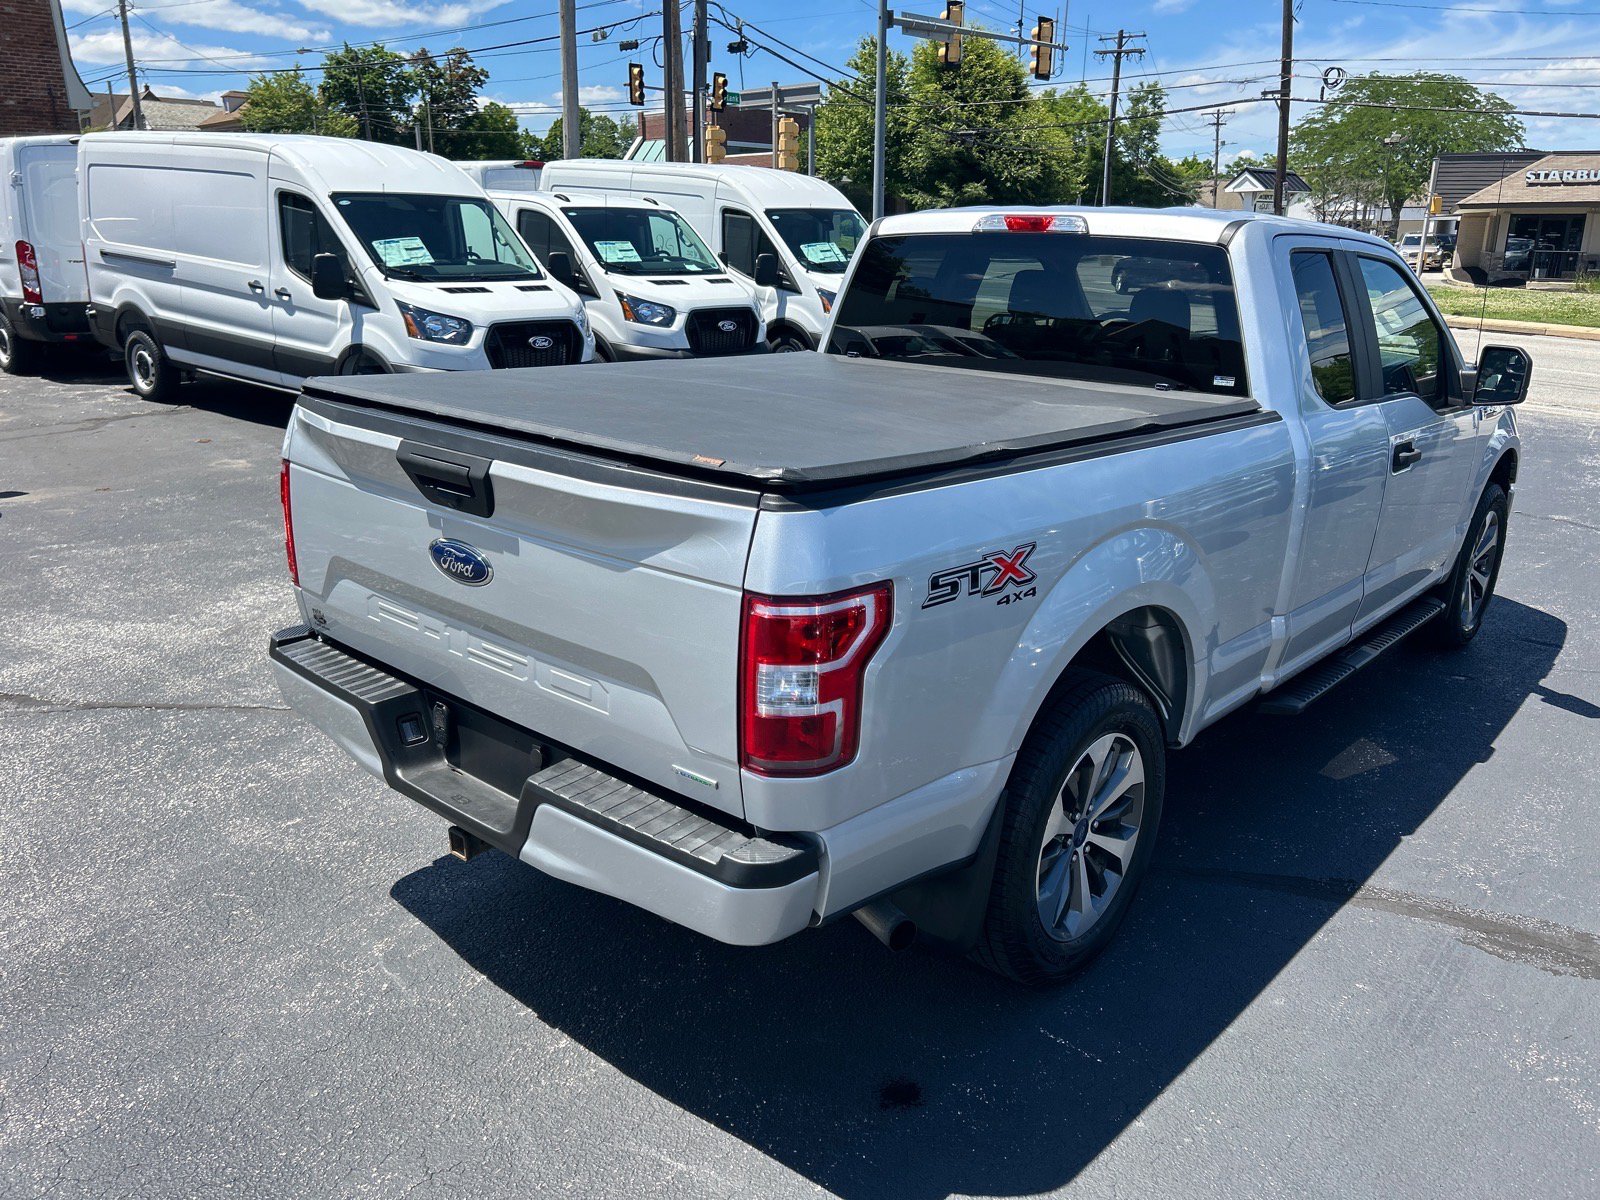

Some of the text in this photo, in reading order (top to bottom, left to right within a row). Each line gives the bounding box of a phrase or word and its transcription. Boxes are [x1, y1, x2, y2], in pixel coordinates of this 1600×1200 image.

[1526, 170, 1600, 183] STARBU
[440, 547, 475, 577] Ford
[921, 541, 1037, 609] STX
[366, 594, 610, 716] F-150
